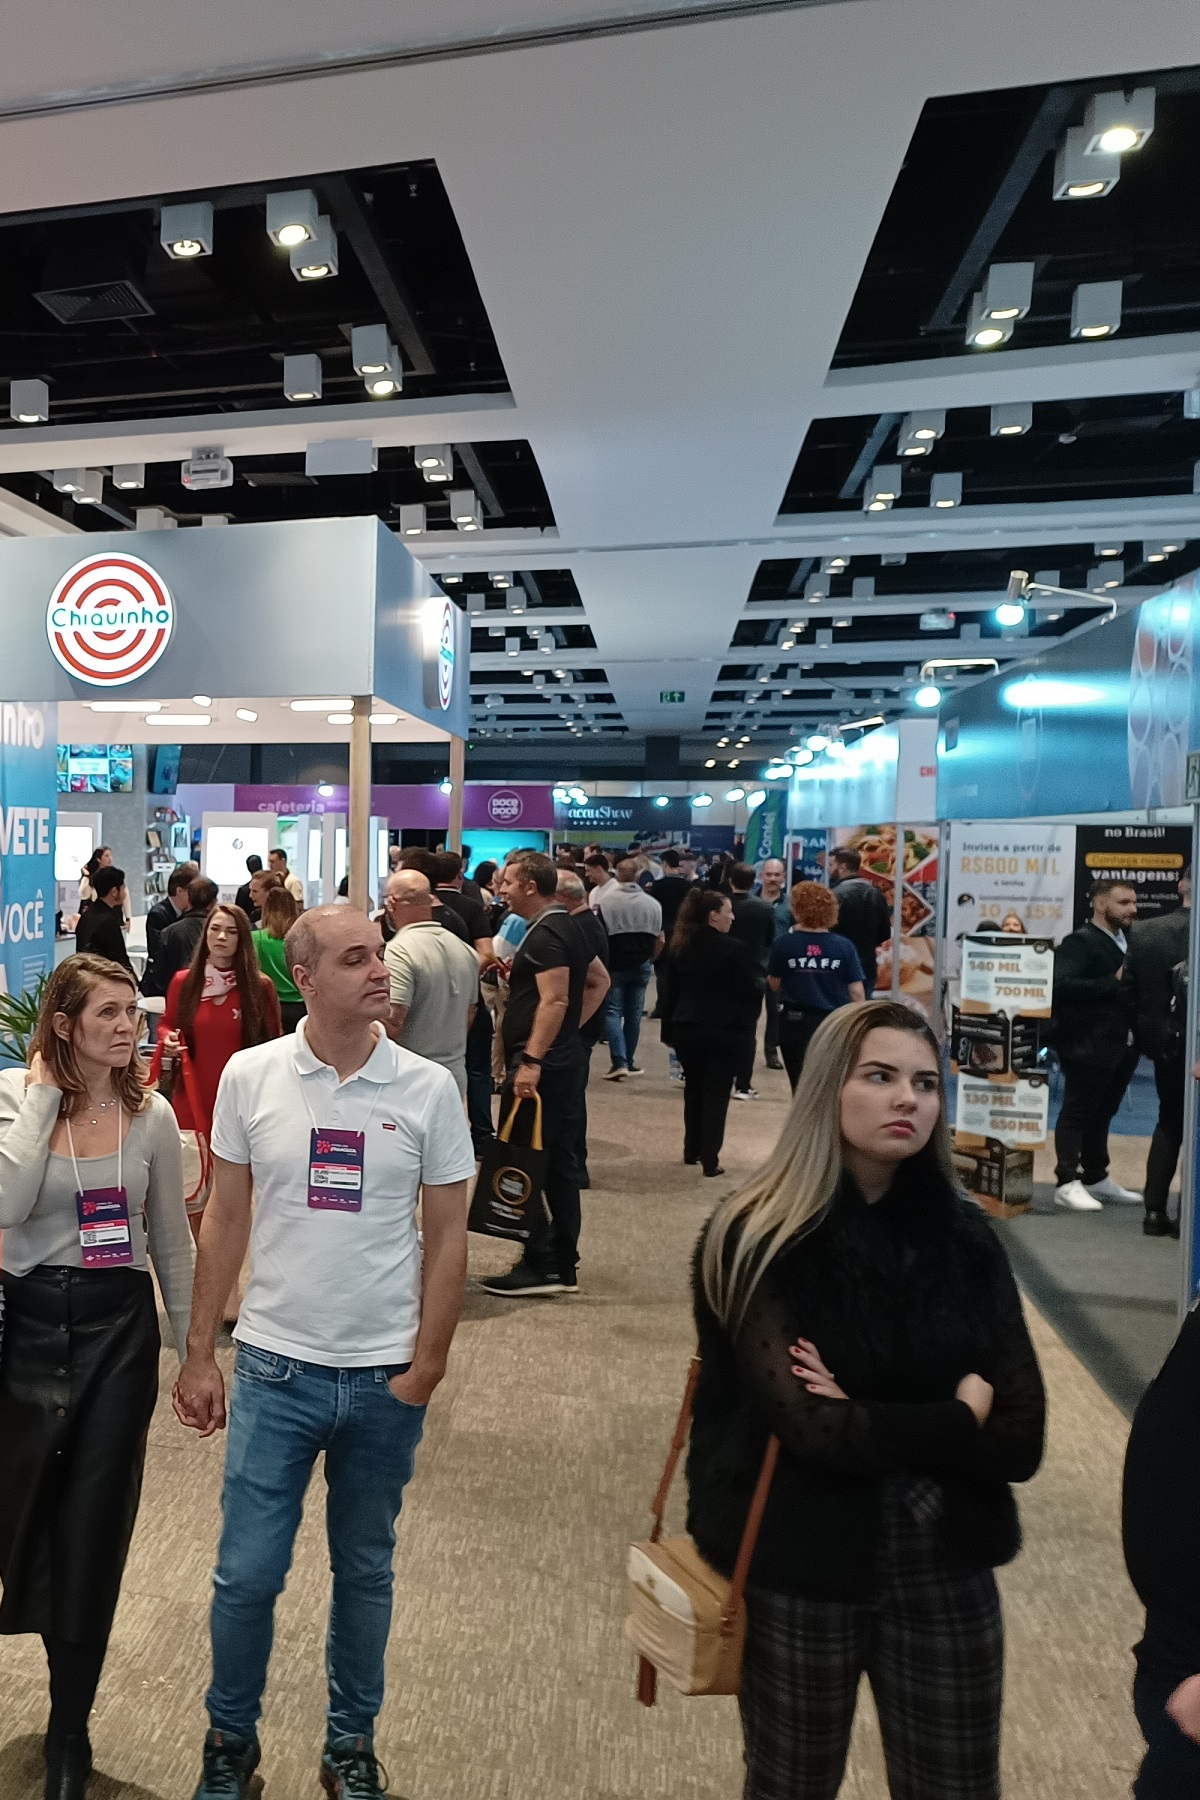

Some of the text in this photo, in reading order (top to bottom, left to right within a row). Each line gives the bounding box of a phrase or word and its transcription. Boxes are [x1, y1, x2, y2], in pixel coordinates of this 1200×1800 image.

[52, 607, 169, 627] Chiquinho
[257, 800, 325, 814] cafeteria
[1104, 827, 1166, 838] no Brasil!
[962, 842, 1000, 852] Invista
[1013, 843, 1044, 853] partir
[1047, 843, 1062, 852] de
[1026, 857, 1060, 876] MIL
[788, 957, 841, 970] STAFF
[999, 962, 1022, 973] MIL
[995, 986, 1021, 997] 700
[1024, 987, 1046, 998] MIL
[991, 1093, 1015, 1107] MIL
[1018, 1120, 1040, 1132] MIL
